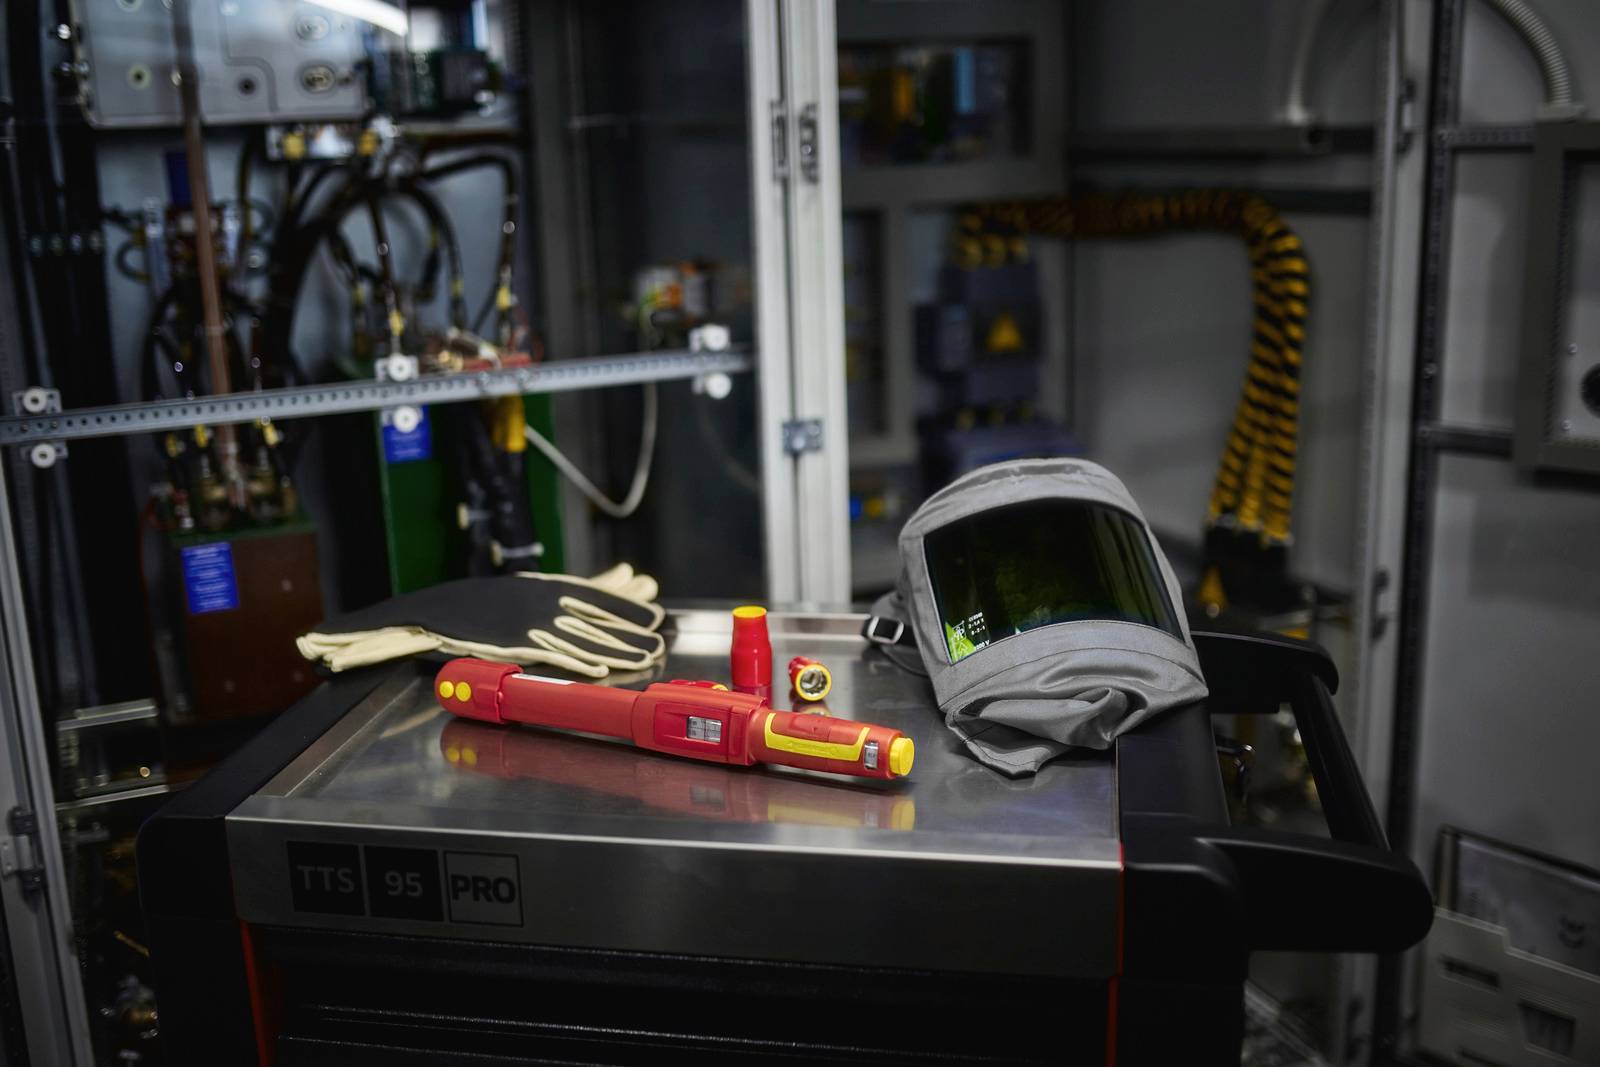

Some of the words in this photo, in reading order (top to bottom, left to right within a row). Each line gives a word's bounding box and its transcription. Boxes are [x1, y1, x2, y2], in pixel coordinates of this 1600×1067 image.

[297, 864, 355, 894] TTS
[384, 870, 423, 897] 95
[450, 873, 517, 905] PRO
